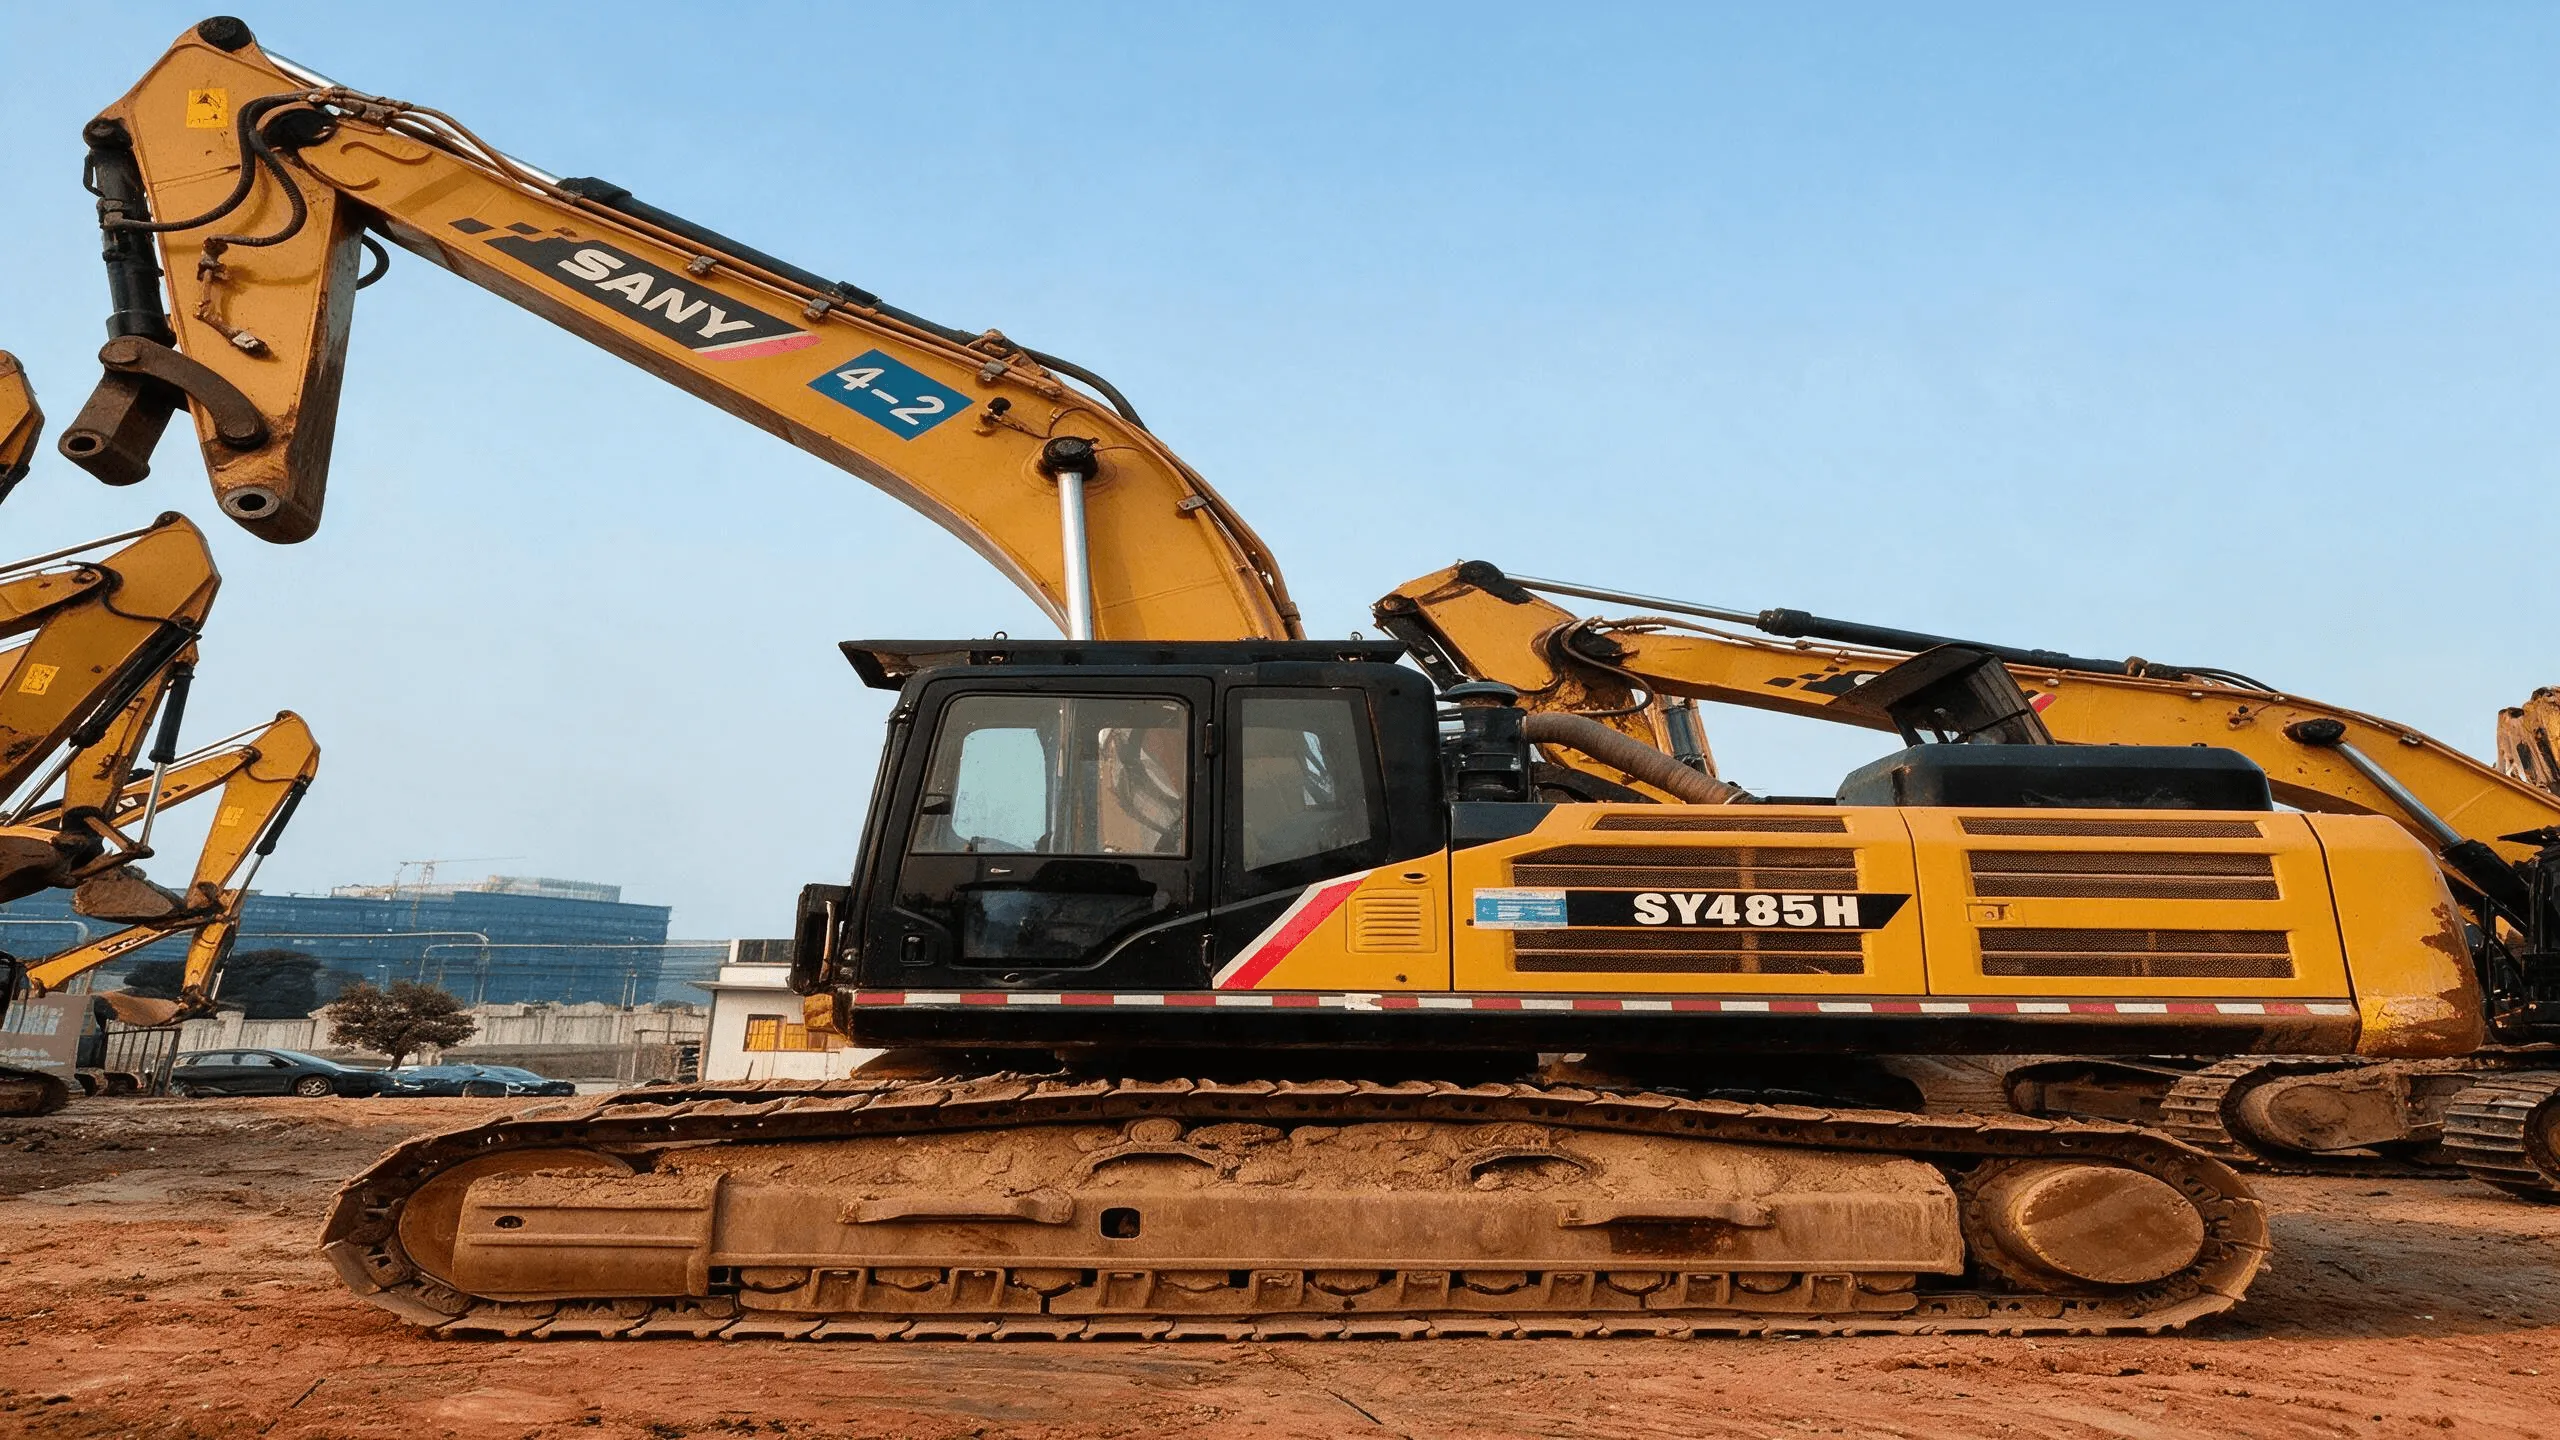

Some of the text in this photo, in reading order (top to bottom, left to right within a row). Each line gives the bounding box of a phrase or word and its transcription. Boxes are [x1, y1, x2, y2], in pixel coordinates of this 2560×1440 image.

[557, 248, 755, 339] SANY
[836, 367, 945, 426] 4-2
[1633, 892, 1860, 927] SY485H
